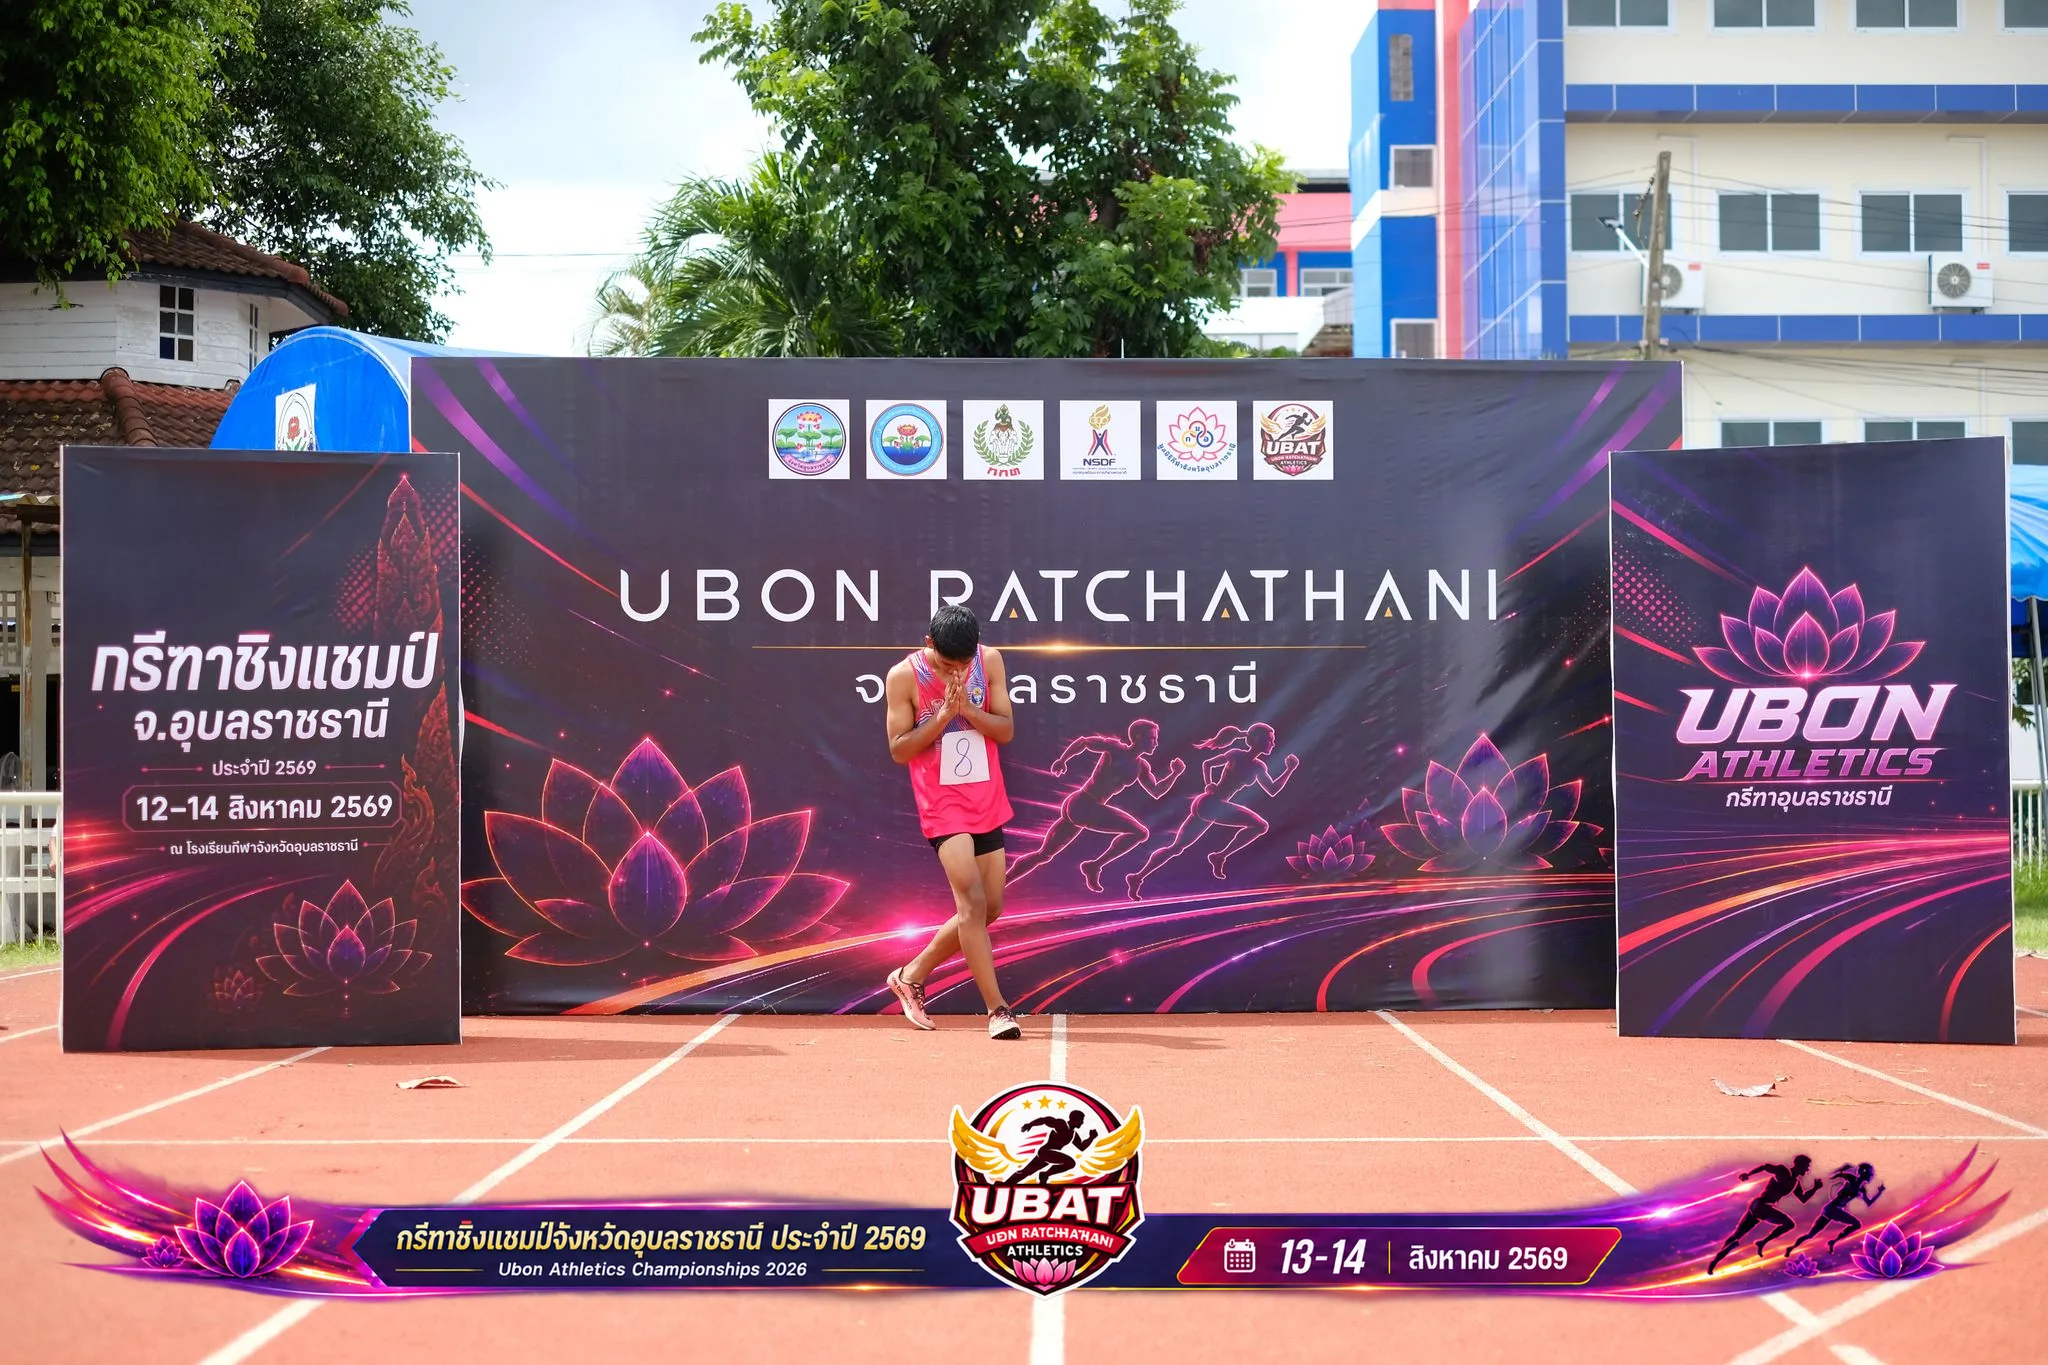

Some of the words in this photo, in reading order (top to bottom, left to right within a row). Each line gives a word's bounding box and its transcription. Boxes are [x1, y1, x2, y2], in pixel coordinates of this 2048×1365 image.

[1083, 458, 1116, 466] NSDF
[1266, 441, 1321, 455] UBAT
[986, 466, 1021, 477] กกท
[620, 569, 880, 623] UBON
[931, 569, 1498, 623] RATCHATHANI
[91, 631, 439, 691] กรีฑาชิงแชมป์
[134, 698, 389, 752] จ.อุบลราชธานี
[1676, 684, 1957, 745] UBON
[212, 759, 270, 777] ประจำปี
[275, 760, 317, 776] 2569
[954, 738, 973, 778] 8
[1682, 747, 1942, 779] ATHLETICS
[228, 795, 322, 821] สิงหาคม
[331, 795, 393, 819] 2569
[1726, 785, 1893, 813] กรีฑาอุบลราชธานี
[170, 844, 183, 856] ณ
[186, 838, 359, 857] โรงเรียนกีฬาจังหวัดอุบลราชธานี
